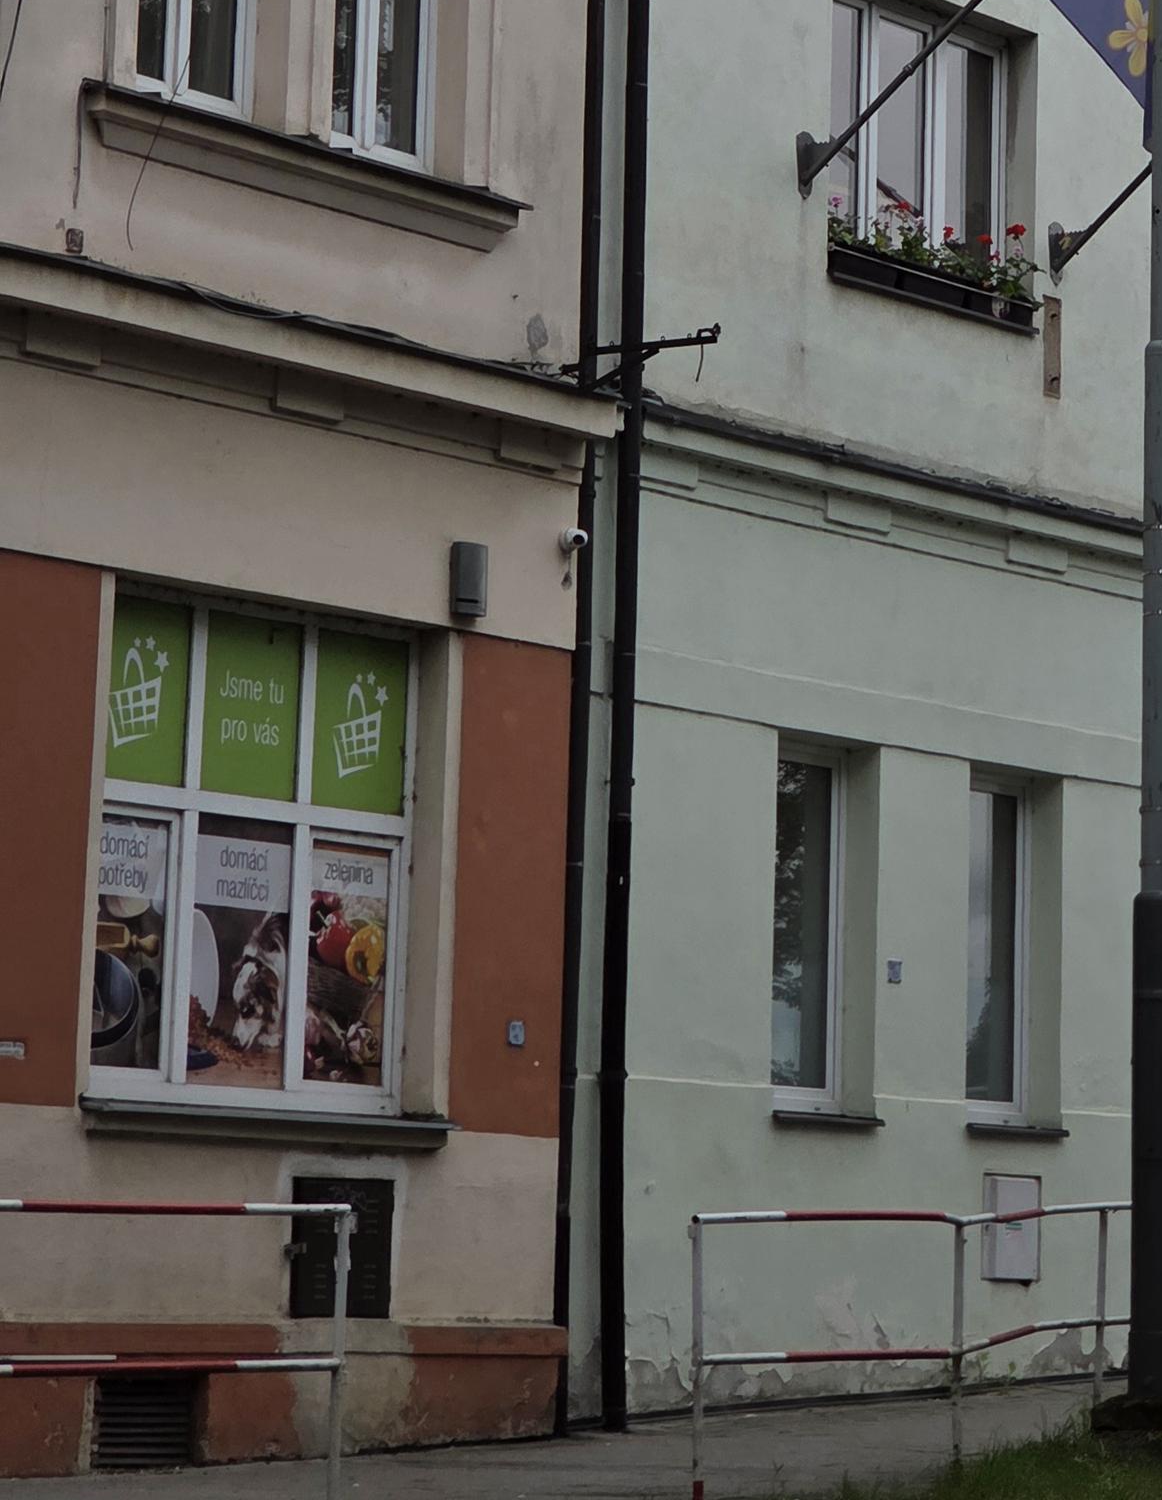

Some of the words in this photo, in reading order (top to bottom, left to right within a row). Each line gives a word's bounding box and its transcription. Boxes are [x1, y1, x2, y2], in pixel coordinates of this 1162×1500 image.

[219, 669, 263, 702] Jsme
[269, 677, 284, 704] tu
[220, 717, 248, 745] pro
[253, 716, 280, 747] vás
[100, 830, 150, 859] domácí
[219, 845, 268, 873] domácí
[97, 862, 148, 893] potřeby
[215, 876, 270, 903] mazlíčci
